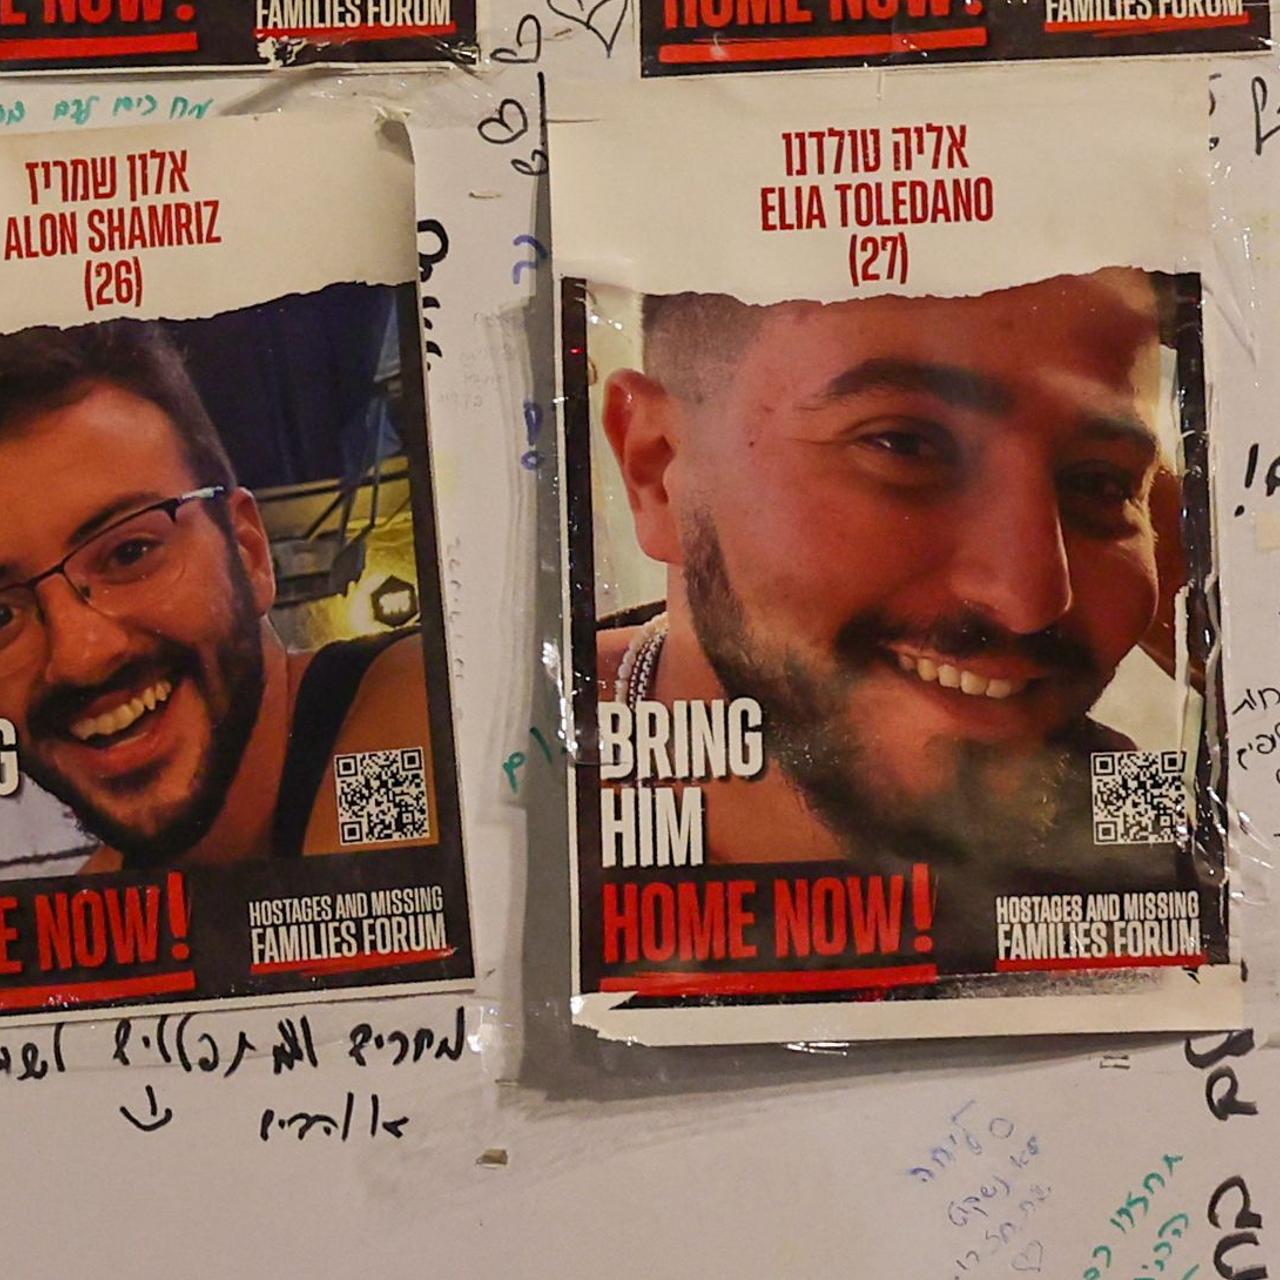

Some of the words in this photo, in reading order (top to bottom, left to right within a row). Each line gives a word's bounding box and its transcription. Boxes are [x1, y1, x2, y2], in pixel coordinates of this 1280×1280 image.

[783, 128, 881, 177] טולדנו
[892, 123, 968, 169] אליה
[24, 156, 117, 204] שמריז
[127, 149, 190, 201] אלון
[4, 212, 79, 260] ALON
[87, 198, 223, 253] SHAMRIZ
[760, 184, 828, 232] ELIA
[836, 176, 995, 228] TOLEDANO
[84, 257, 144, 310] (26)
[849, 232, 909, 287] (27)
[598, 692, 762, 781] BRING
[601, 787, 702, 867] HIM
[39, 868, 193, 976] NOW!
[250, 896, 335, 927] HOSTAGES
[336, 893, 367, 919] AND
[372, 886, 443, 918] MISSING
[603, 880, 758, 963] HOME
[771, 859, 935, 958] NOW!
[997, 895, 1085, 925] HOSTAGES
[1087, 895, 1119, 922] AND
[1124, 891, 1198, 920] MISSING
[251, 920, 357, 964] FAMILIES
[362, 911, 446, 954] FORUM
[997, 920, 1107, 960] FAMILIES
[1112, 917, 1200, 957] FORUM
